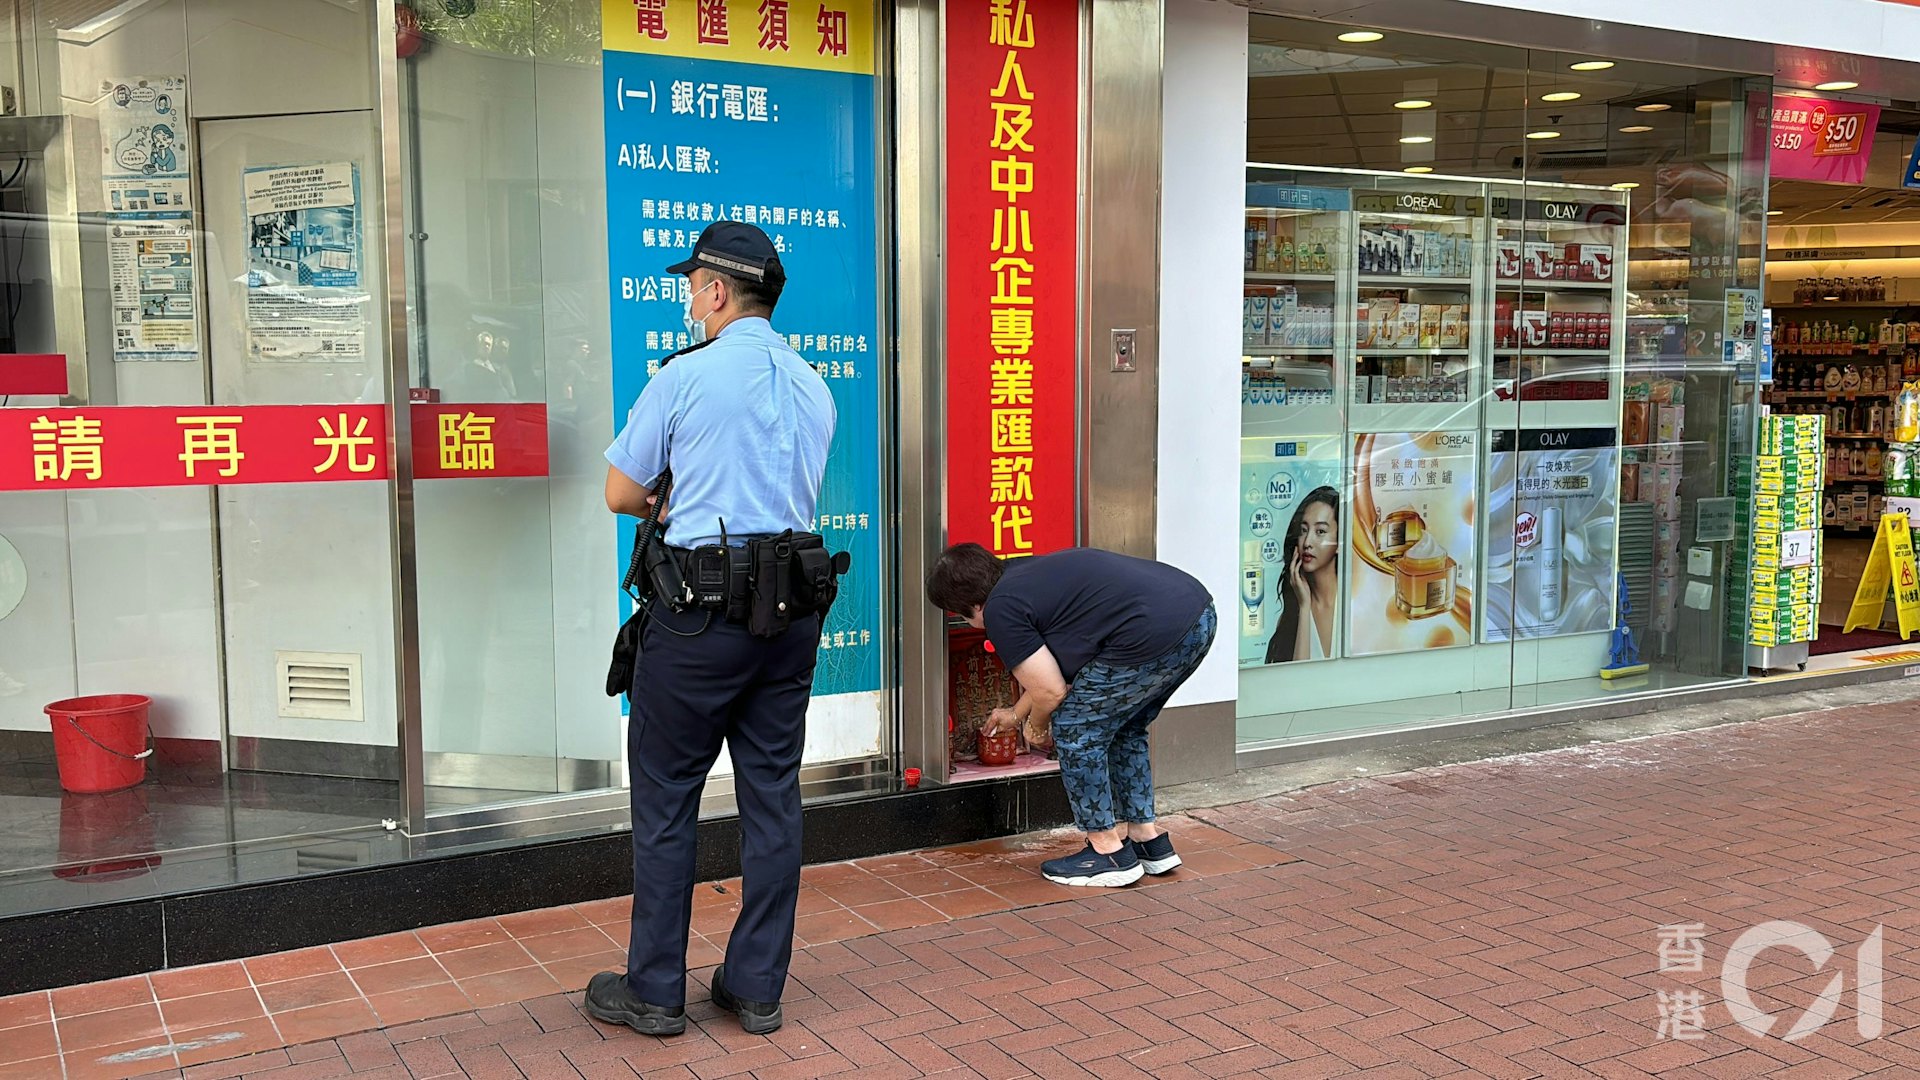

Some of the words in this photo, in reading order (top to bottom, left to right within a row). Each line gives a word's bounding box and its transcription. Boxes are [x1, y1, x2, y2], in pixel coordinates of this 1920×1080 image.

[632, 0, 849, 57] 電匯須知
[1825, 116, 1858, 142] $50
[1773, 133, 1802, 150] $150
[1545, 203, 1578, 219] OLAY
[989, 0, 1035, 559] 私人及中小企專業匯款代
[30, 411, 496, 482] 請再光臨
[1540, 433, 1570, 446] OLAY
[1270, 480, 1293, 494] No.1
[1374, 470, 1453, 488] 膠原小蜜罐
[1789, 543, 1800, 558] 37
